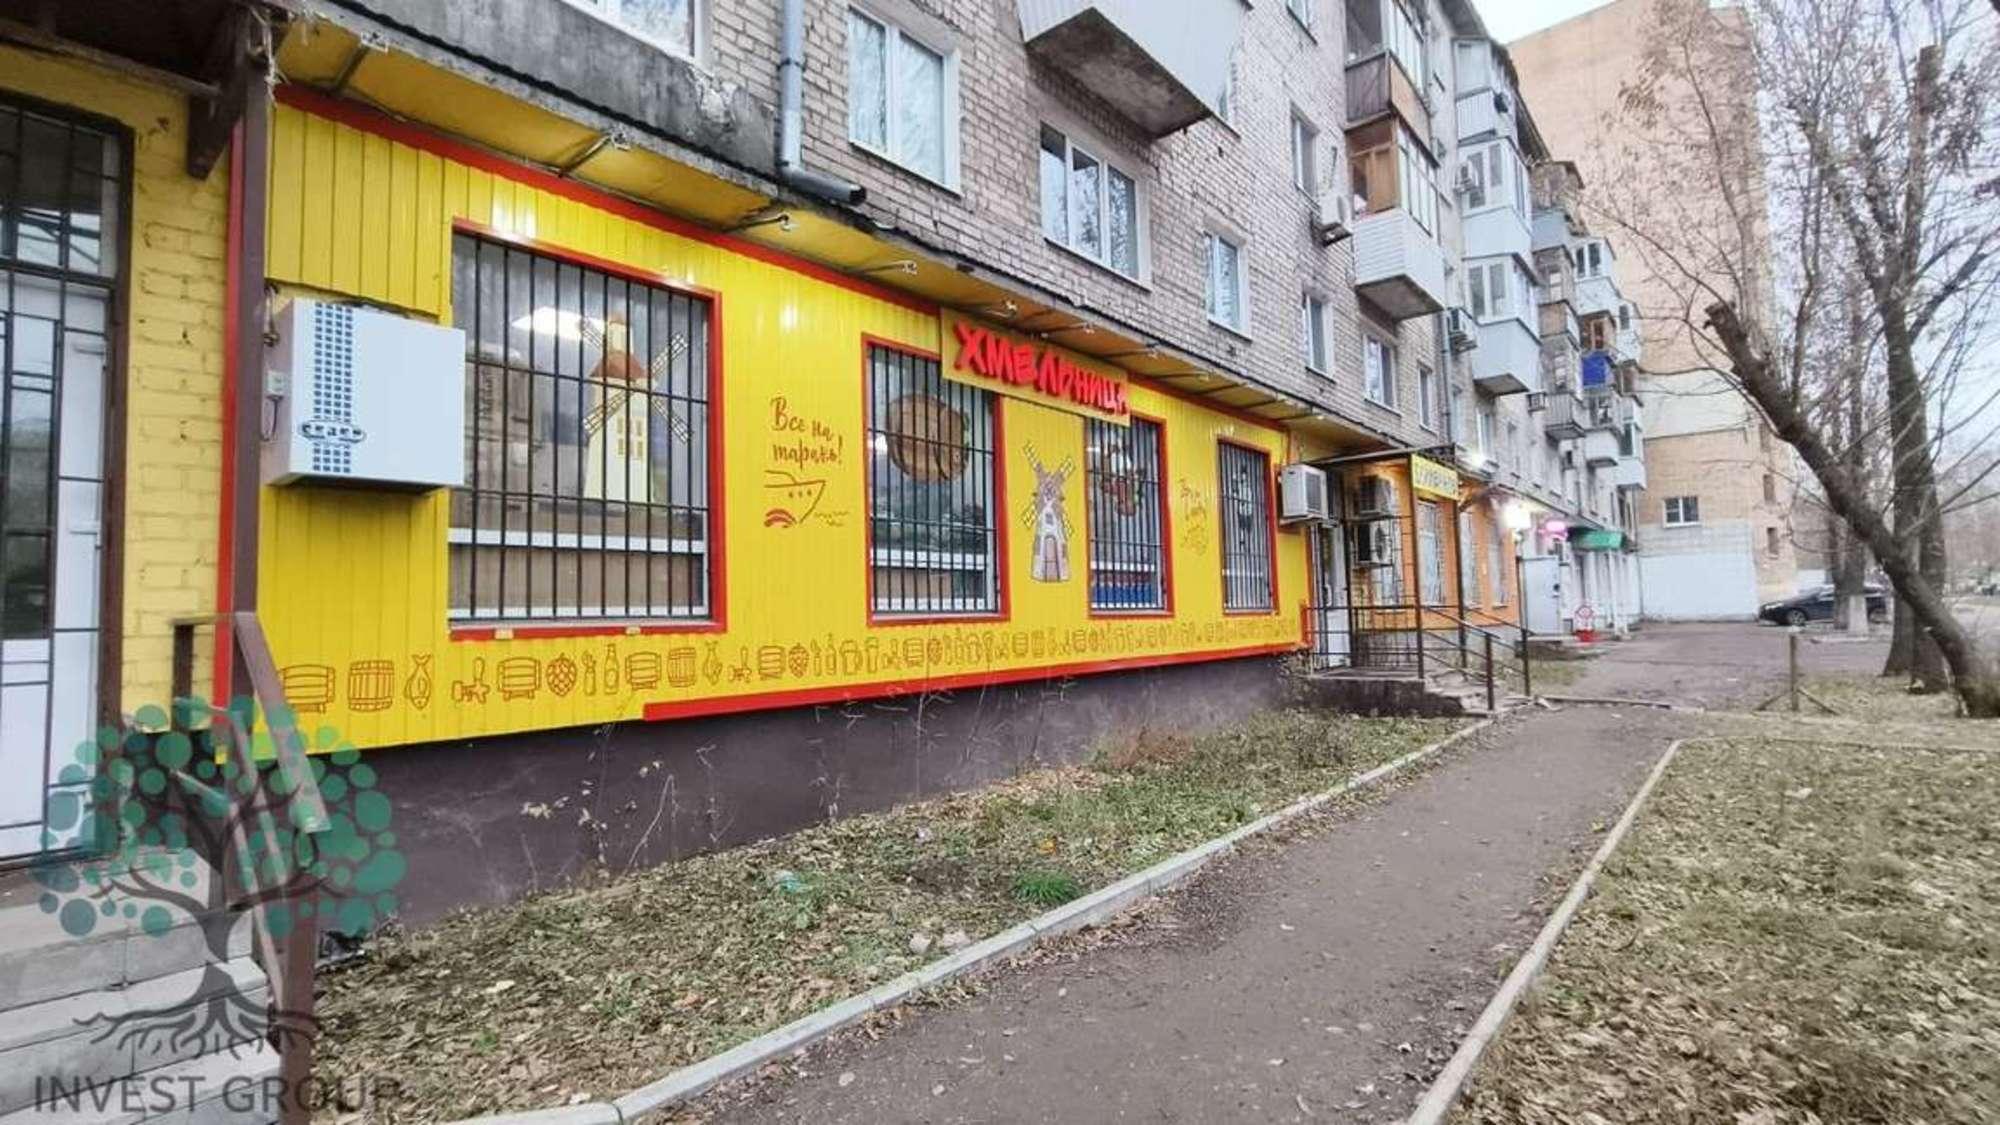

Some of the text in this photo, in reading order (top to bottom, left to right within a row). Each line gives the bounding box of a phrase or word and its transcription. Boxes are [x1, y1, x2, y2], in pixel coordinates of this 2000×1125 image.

[953, 320, 1128, 415] ХМЕЛЬНИЦА
[769, 396, 835, 442] Все на
